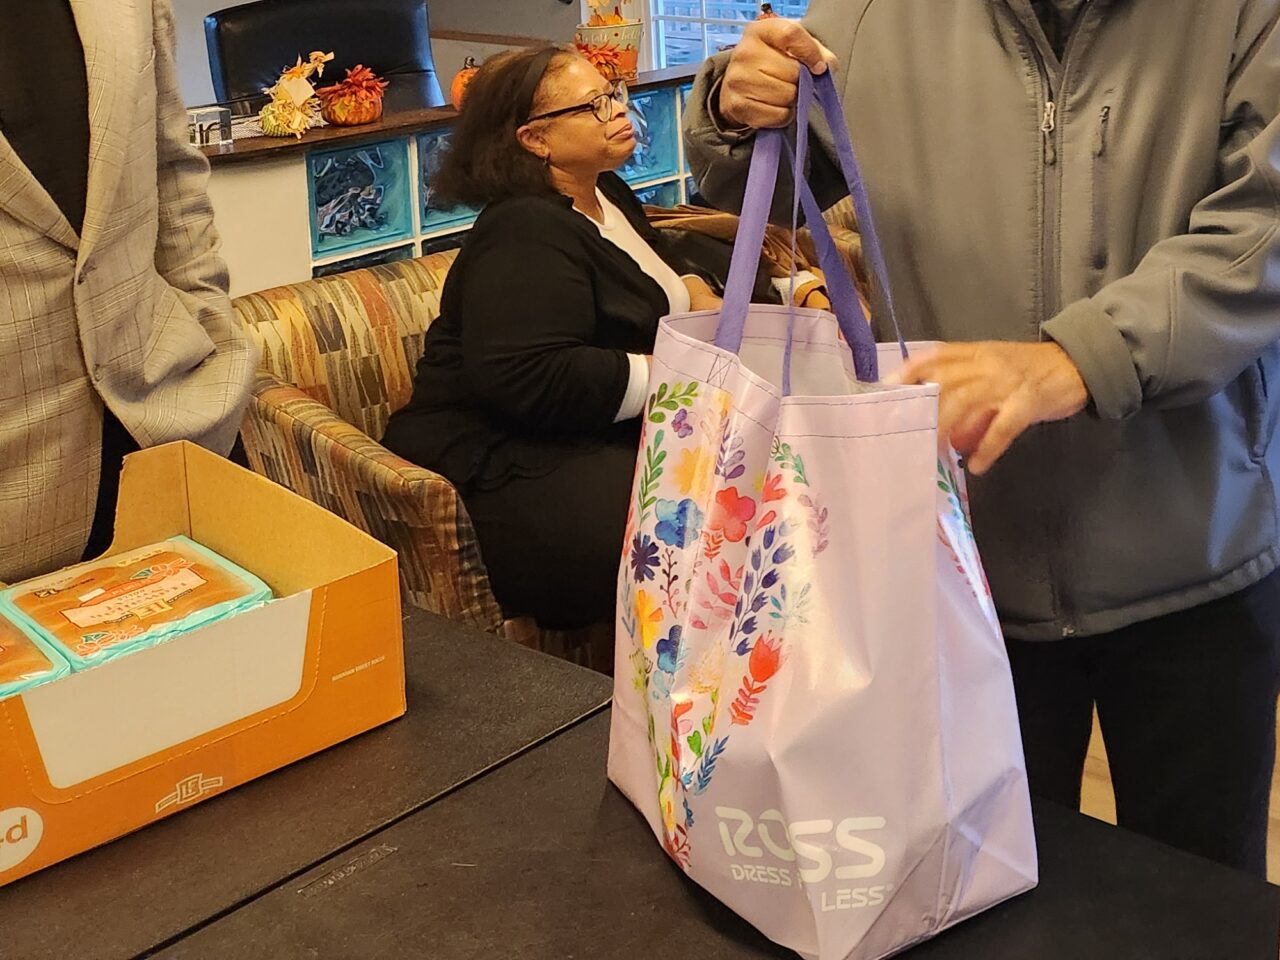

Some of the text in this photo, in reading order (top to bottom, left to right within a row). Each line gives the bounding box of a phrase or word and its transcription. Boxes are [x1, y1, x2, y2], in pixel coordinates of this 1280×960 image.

[715, 806, 886, 883] ROSS
[731, 863, 792, 888] DRESS
[821, 885, 885, 912] LESS
